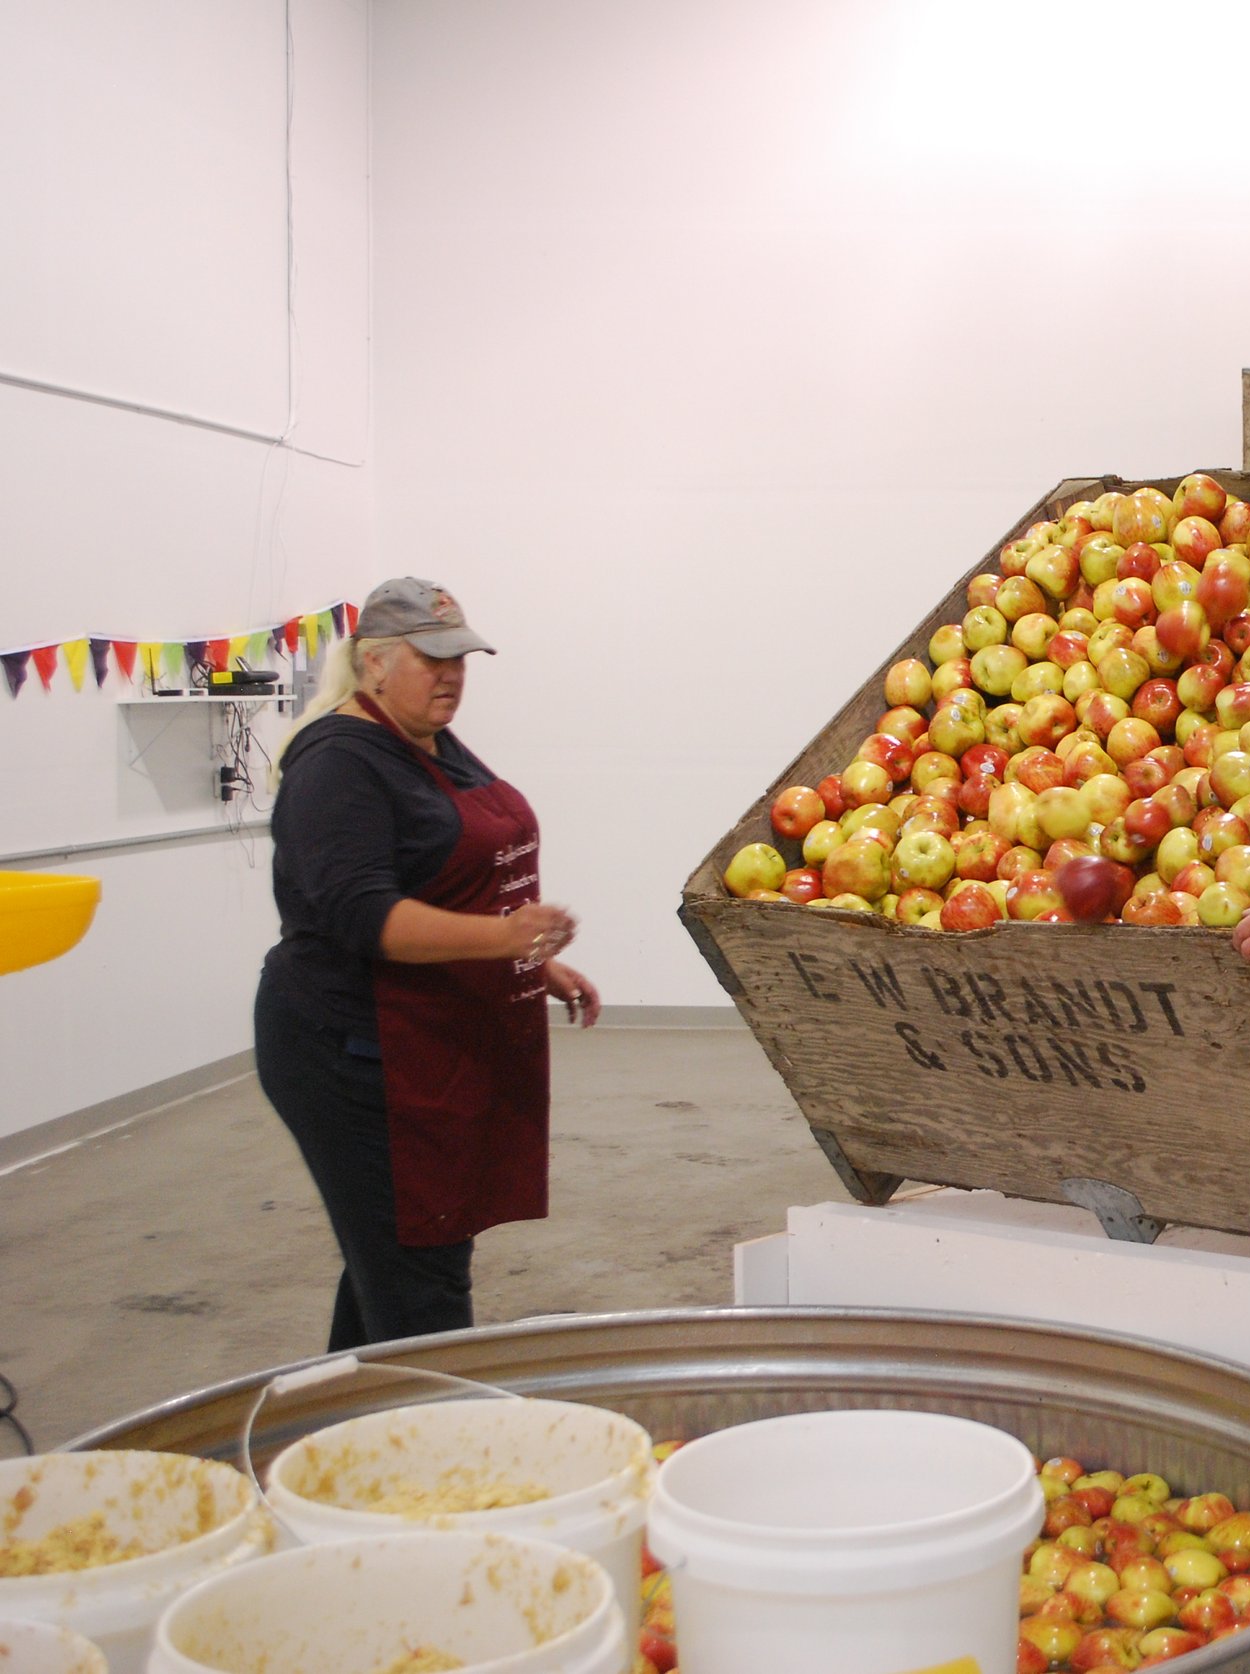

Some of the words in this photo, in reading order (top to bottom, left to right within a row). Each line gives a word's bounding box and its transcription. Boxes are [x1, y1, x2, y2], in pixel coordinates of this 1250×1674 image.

[920, 965, 1186, 1037] BRANDT
[895, 1021, 948, 1072] &
[961, 1029, 1147, 1094] SONS
